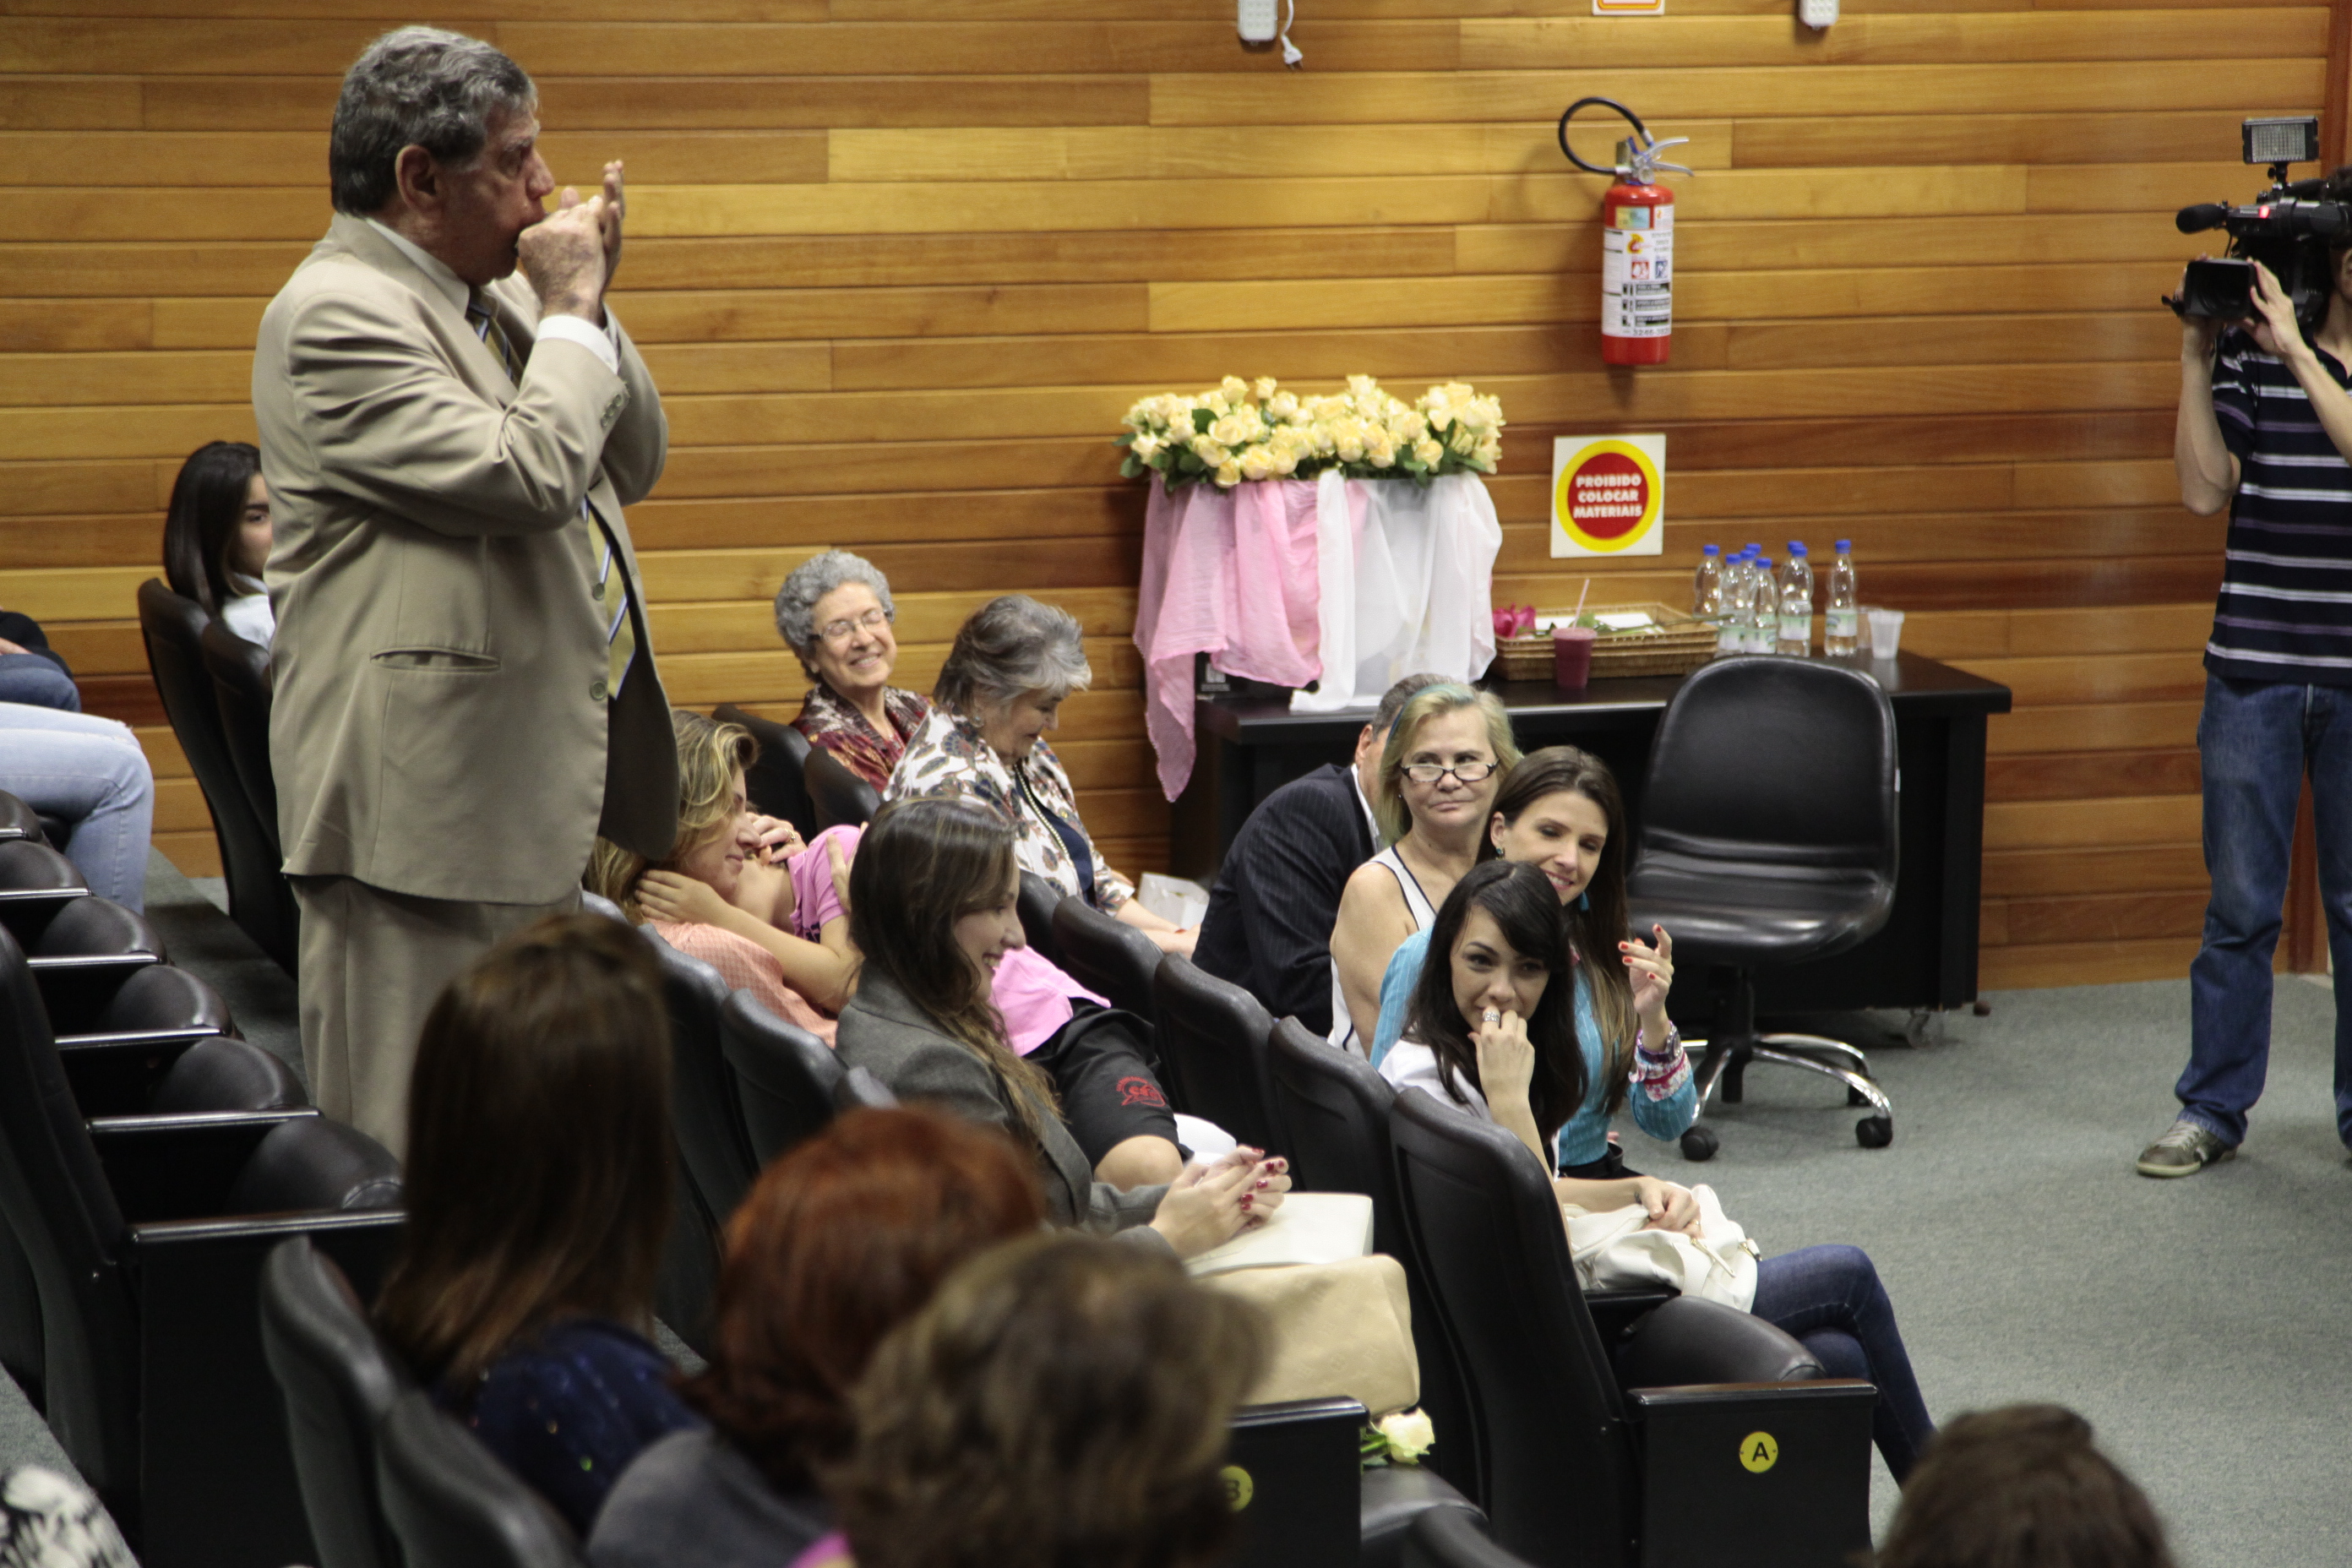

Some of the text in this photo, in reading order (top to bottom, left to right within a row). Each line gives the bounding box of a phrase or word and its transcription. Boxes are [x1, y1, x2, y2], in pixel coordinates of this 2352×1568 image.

[1576, 473, 1642, 487] PROIBIDO
[1577, 489, 1639, 503] COLOCAR
[1573, 504, 1642, 518] MATERIAIS
[1751, 1441, 1770, 1462] A
